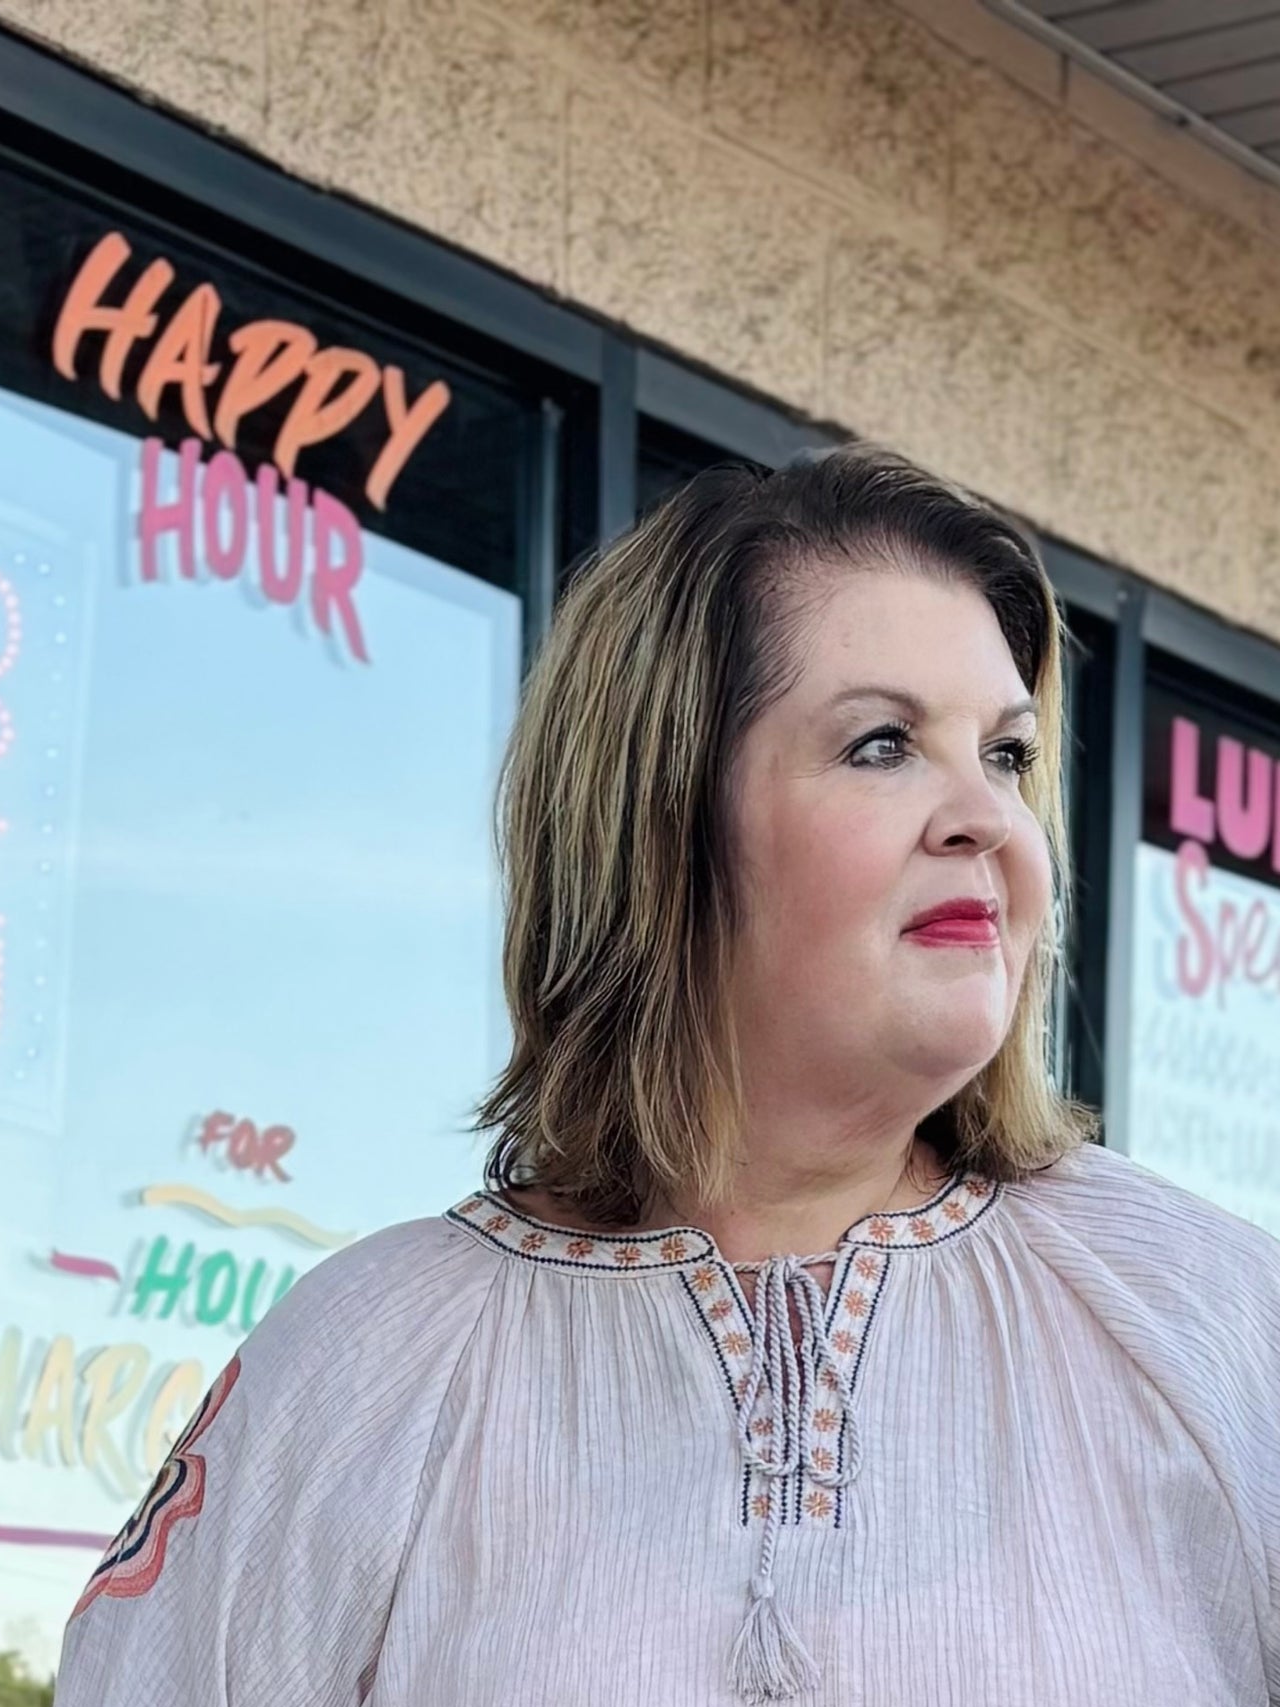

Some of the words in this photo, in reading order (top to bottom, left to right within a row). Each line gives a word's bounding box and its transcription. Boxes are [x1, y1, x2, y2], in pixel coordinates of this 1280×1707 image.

[52, 231, 451, 512] HAPPY
[139, 437, 373, 667] HOUR
[200, 1110, 296, 1183] FOR
